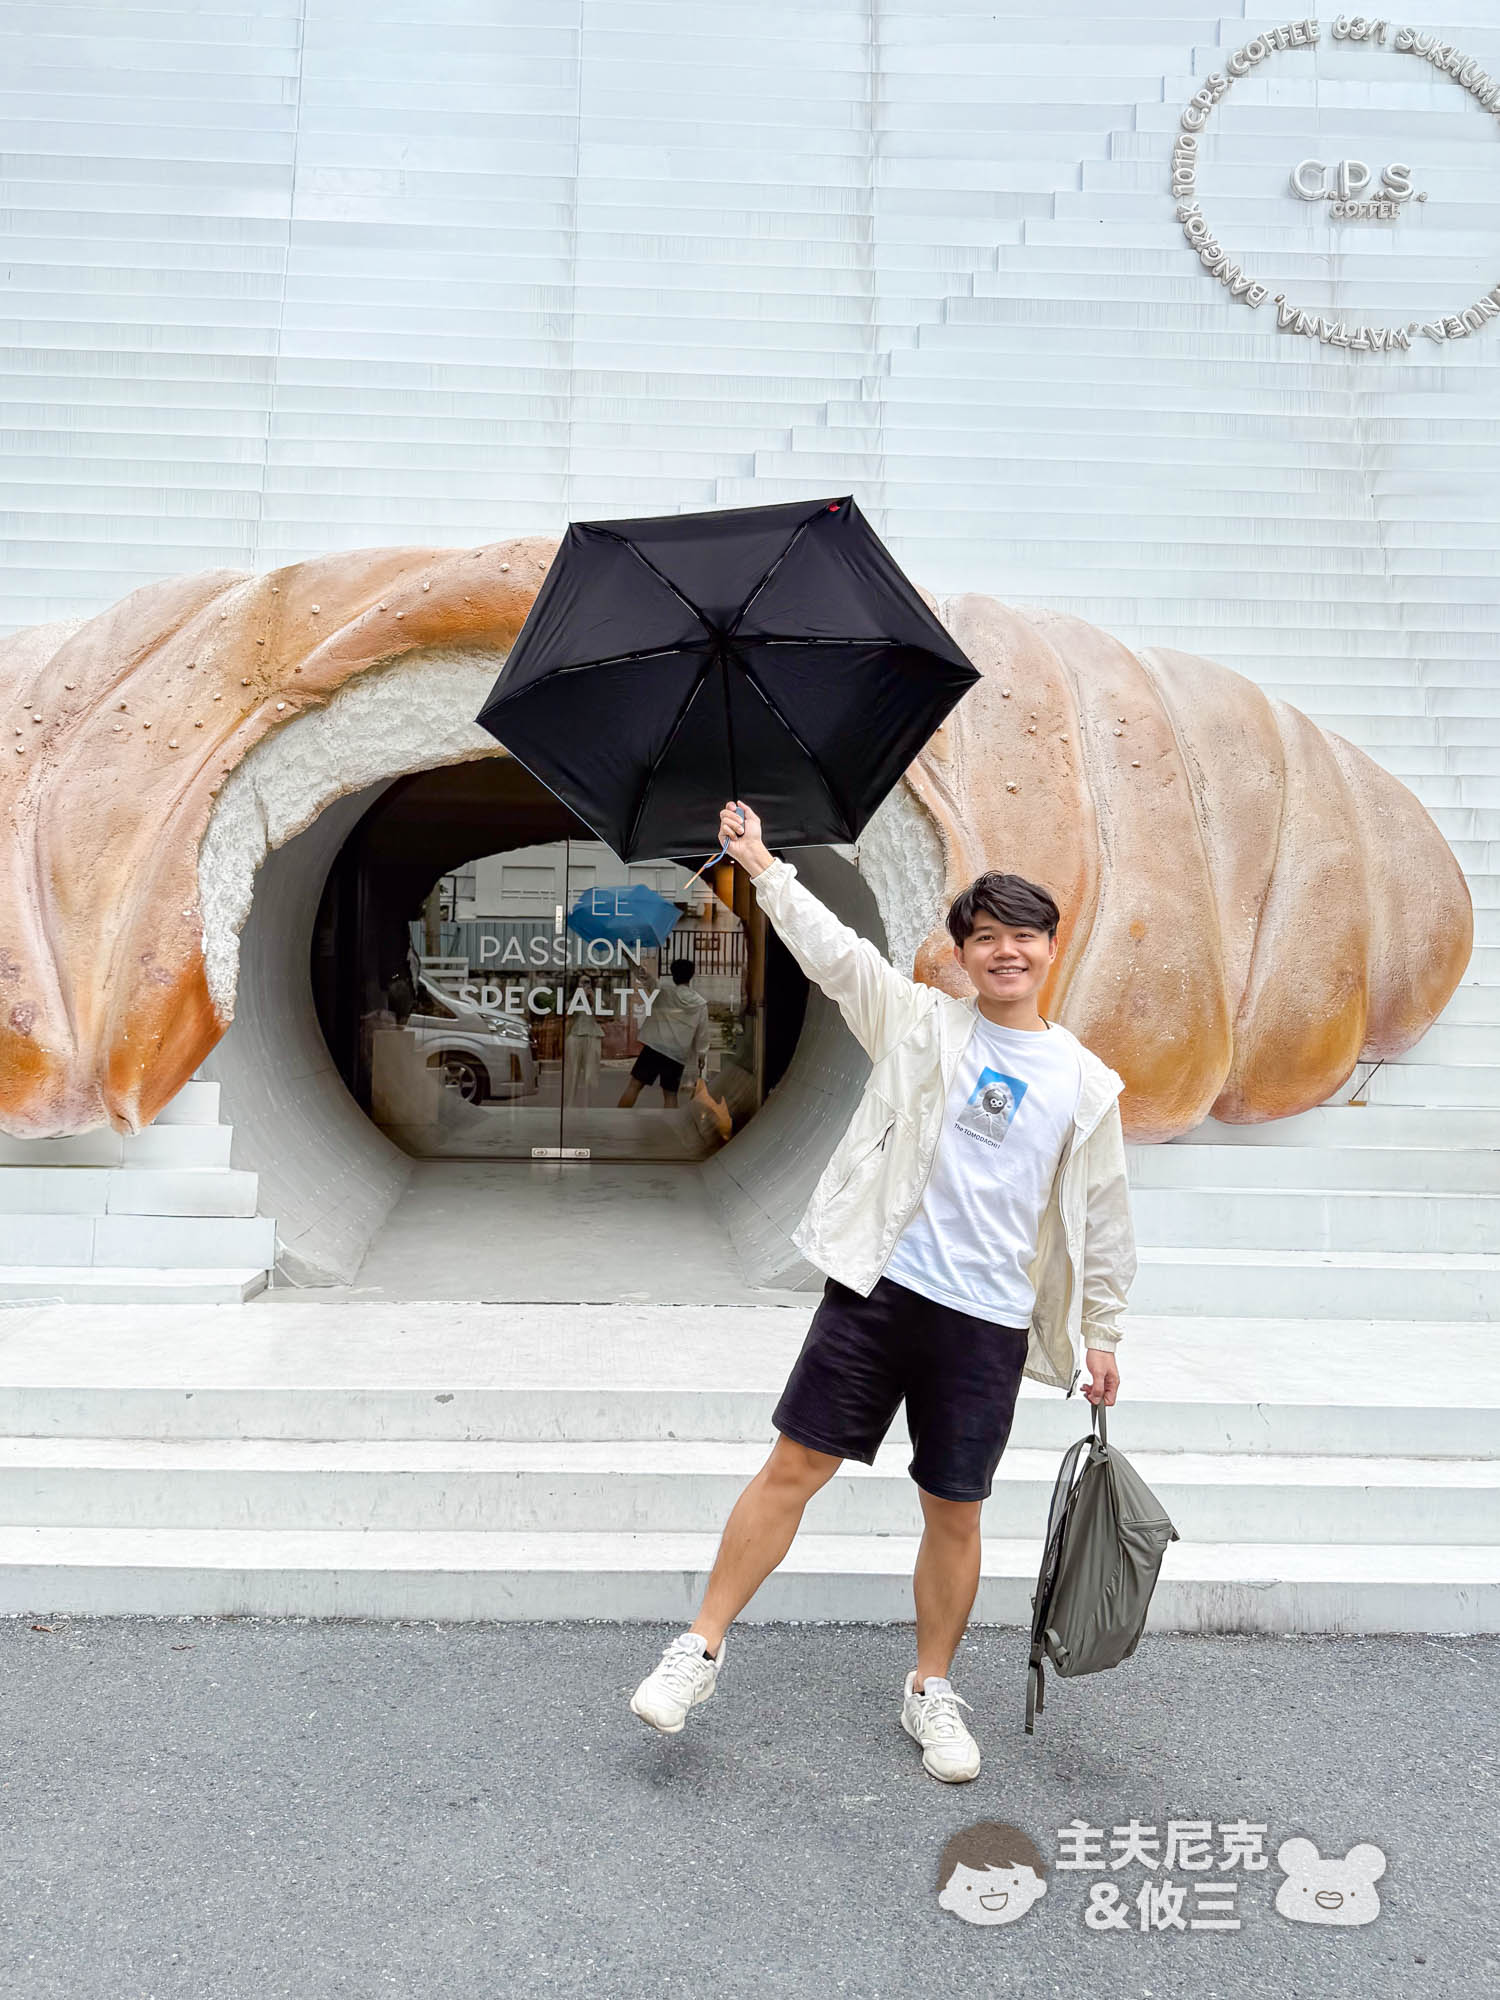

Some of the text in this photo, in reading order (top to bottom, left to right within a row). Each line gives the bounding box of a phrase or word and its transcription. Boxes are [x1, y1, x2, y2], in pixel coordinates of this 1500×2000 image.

[1181, 72, 1233, 133] C.P.S.
[1227, 19, 1320, 77] COFFEE
[1332, 14, 1387, 44] 63/1
[1172, 134, 1198, 198] 10110
[1289, 159, 1428, 202] C.P.S.
[1329, 200, 1401, 219] COFFEE
[1176, 203, 1268, 309] BANGKOK
[479, 936, 641, 967] PASSION
[459, 984, 661, 1017] SPECIALTY
